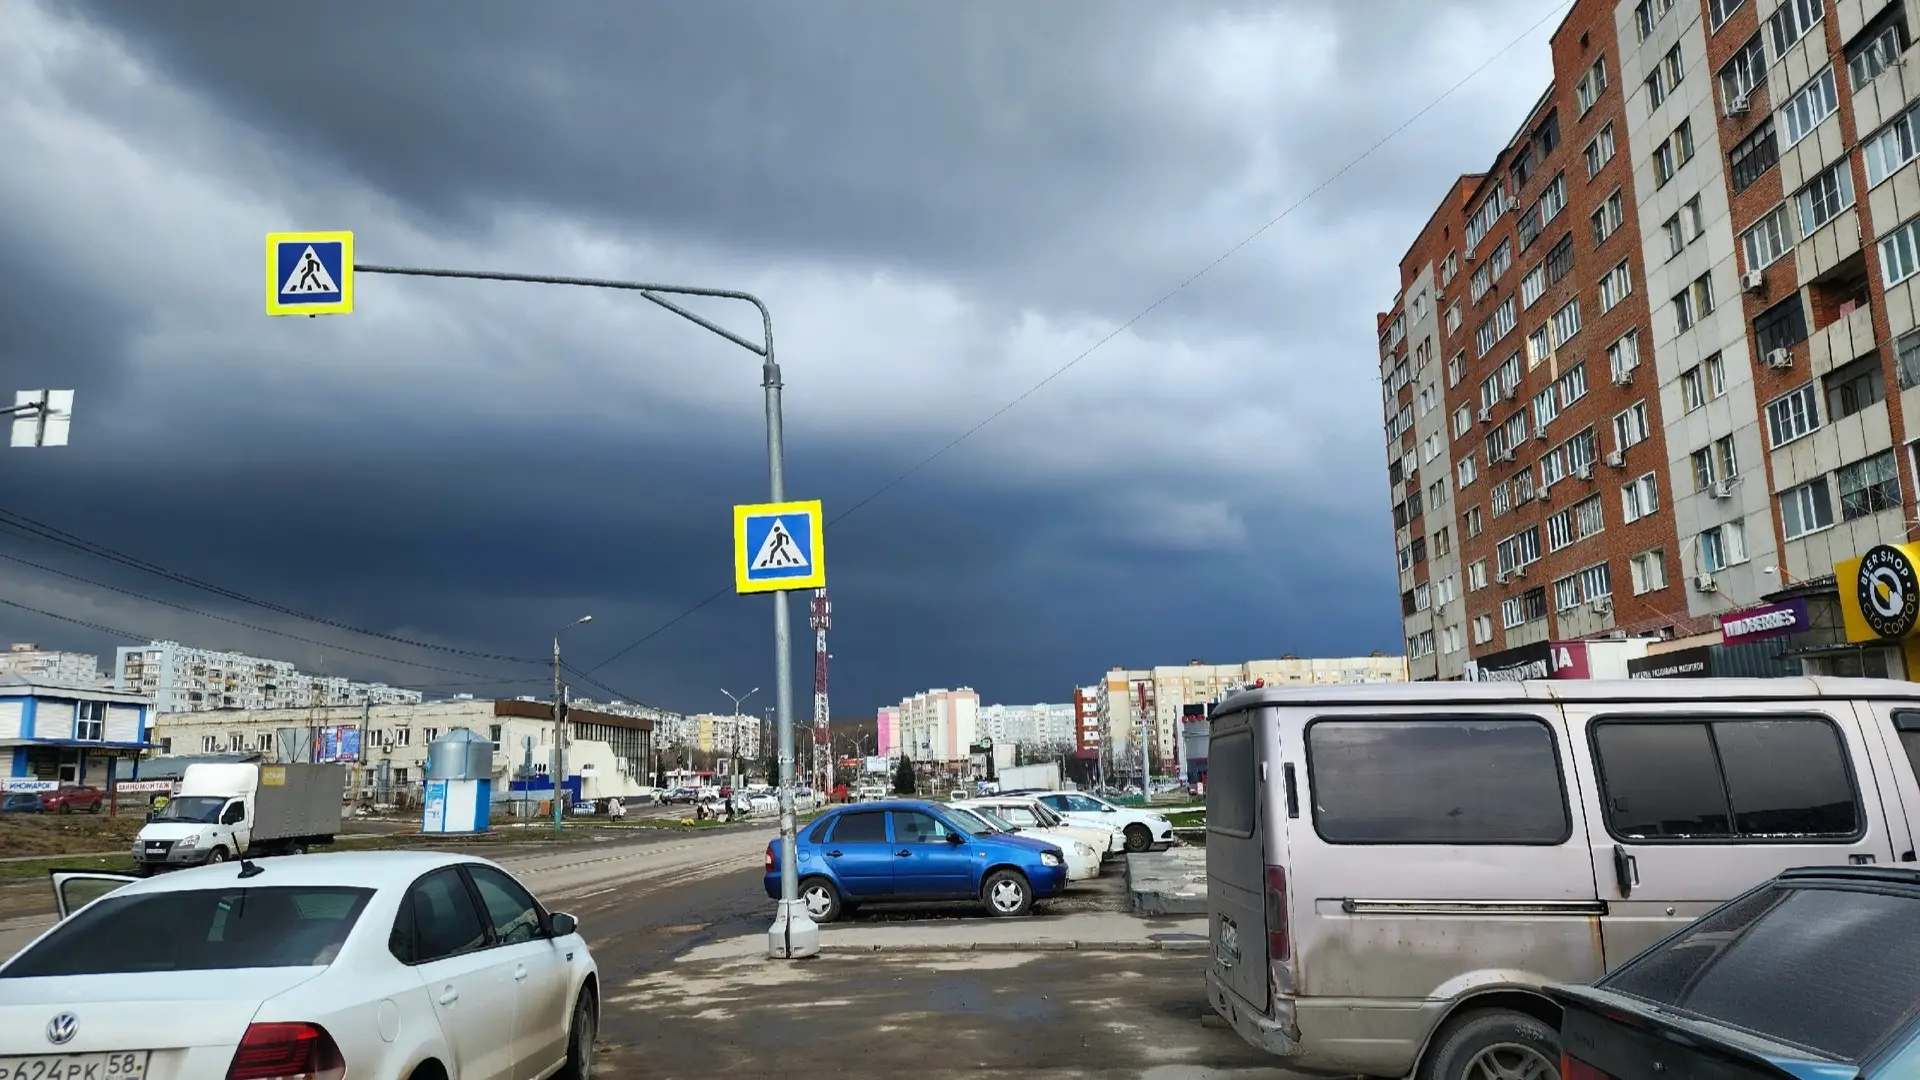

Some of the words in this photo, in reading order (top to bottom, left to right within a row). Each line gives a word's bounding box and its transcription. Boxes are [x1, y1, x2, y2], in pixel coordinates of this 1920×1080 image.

[1861, 554, 1878, 585] BEER
[1881, 551, 1908, 576] SHOP
[1723, 609, 1796, 638] WILDBERRIES
[1864, 602, 1882, 629] СТО
[1884, 593, 1916, 634] СОРТОВ
[118, 782, 170, 791] ШИНОМОНТАЖ
[108, 1054, 136, 1074] 58
